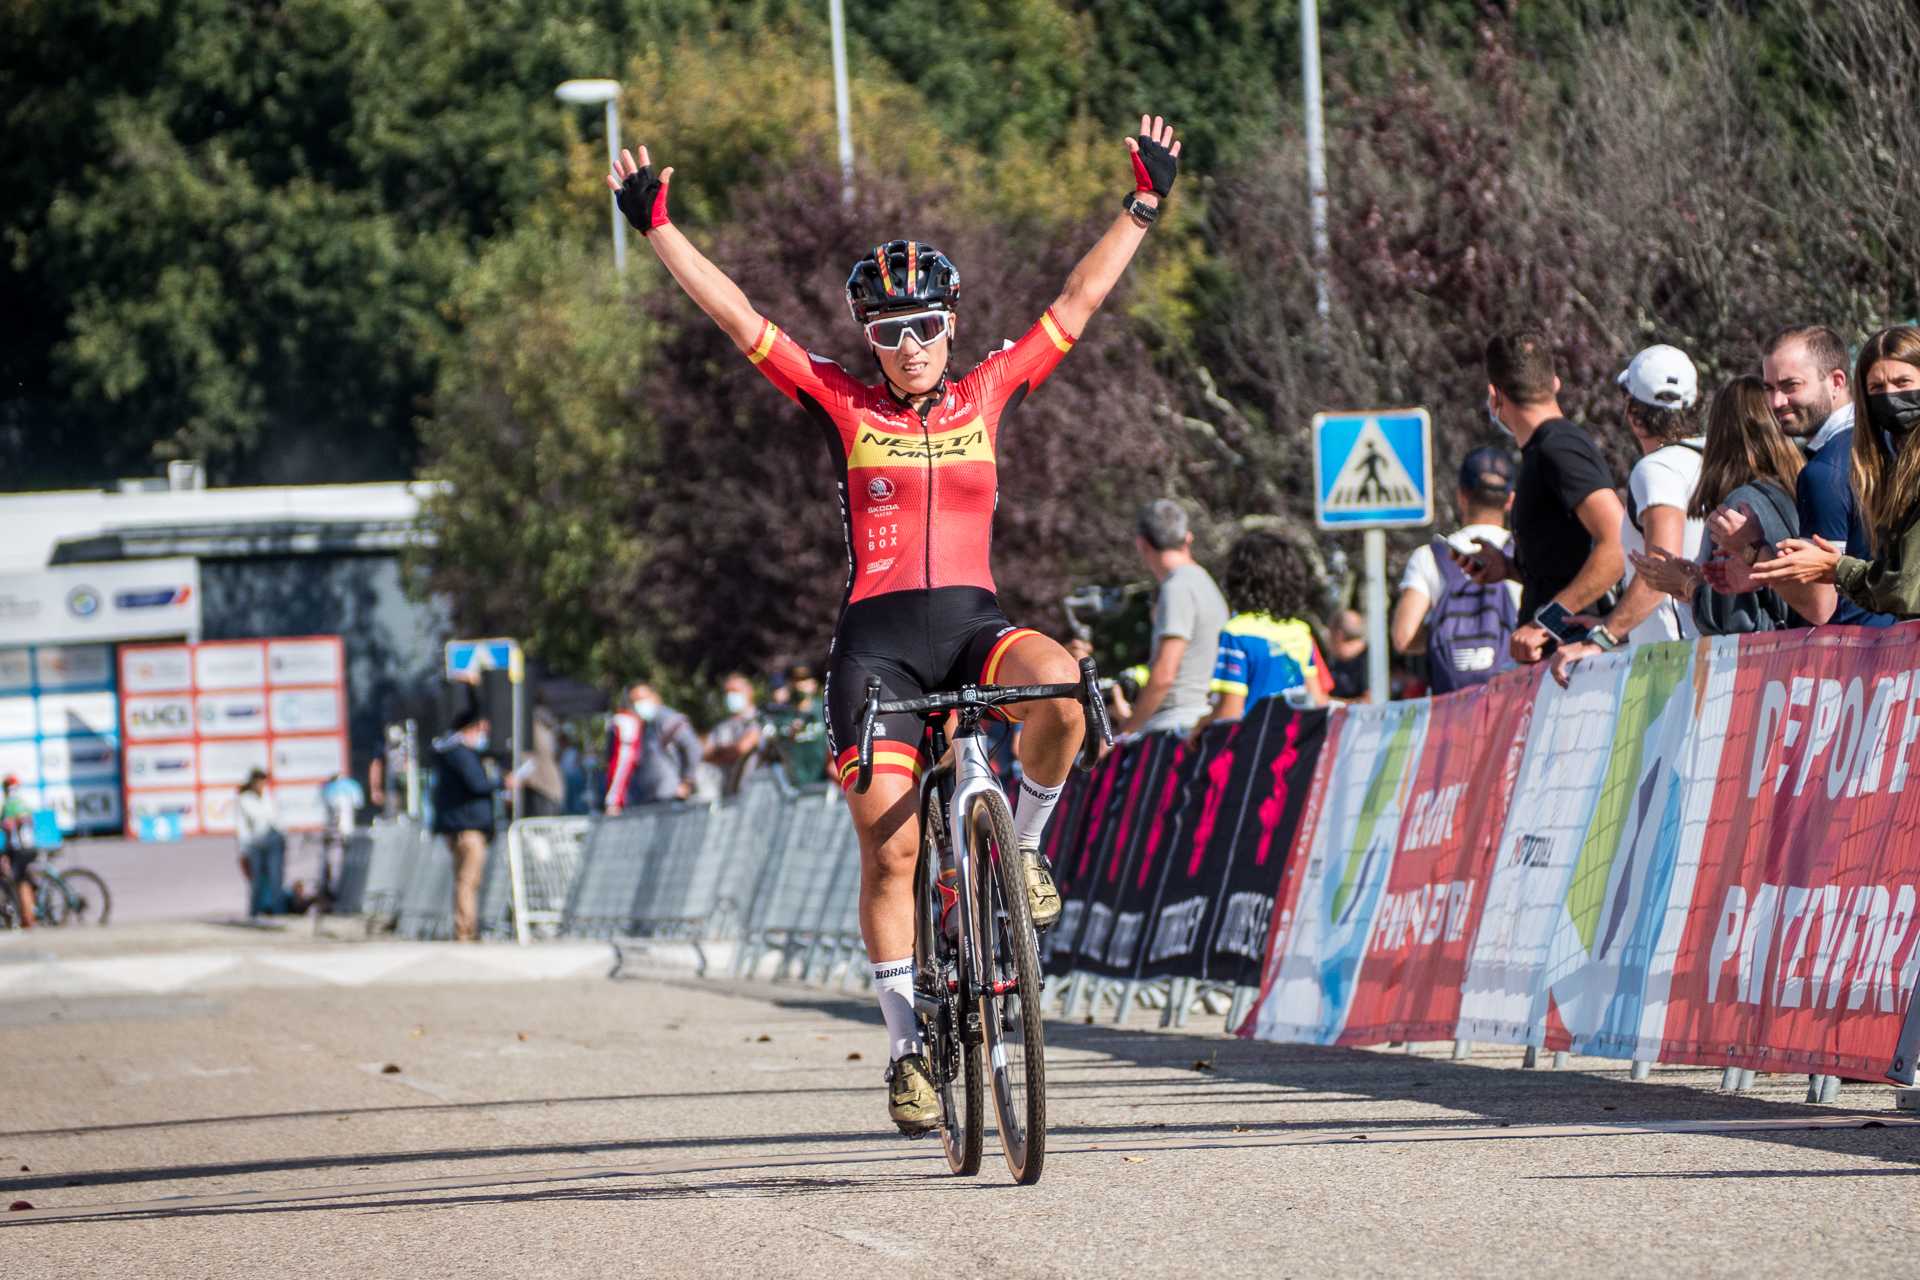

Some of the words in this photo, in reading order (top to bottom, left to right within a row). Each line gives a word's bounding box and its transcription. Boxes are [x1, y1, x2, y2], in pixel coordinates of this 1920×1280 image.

[861, 430, 982, 449] NESTA
[887, 448, 966, 458] MMR
[868, 537, 897, 551] BOX
